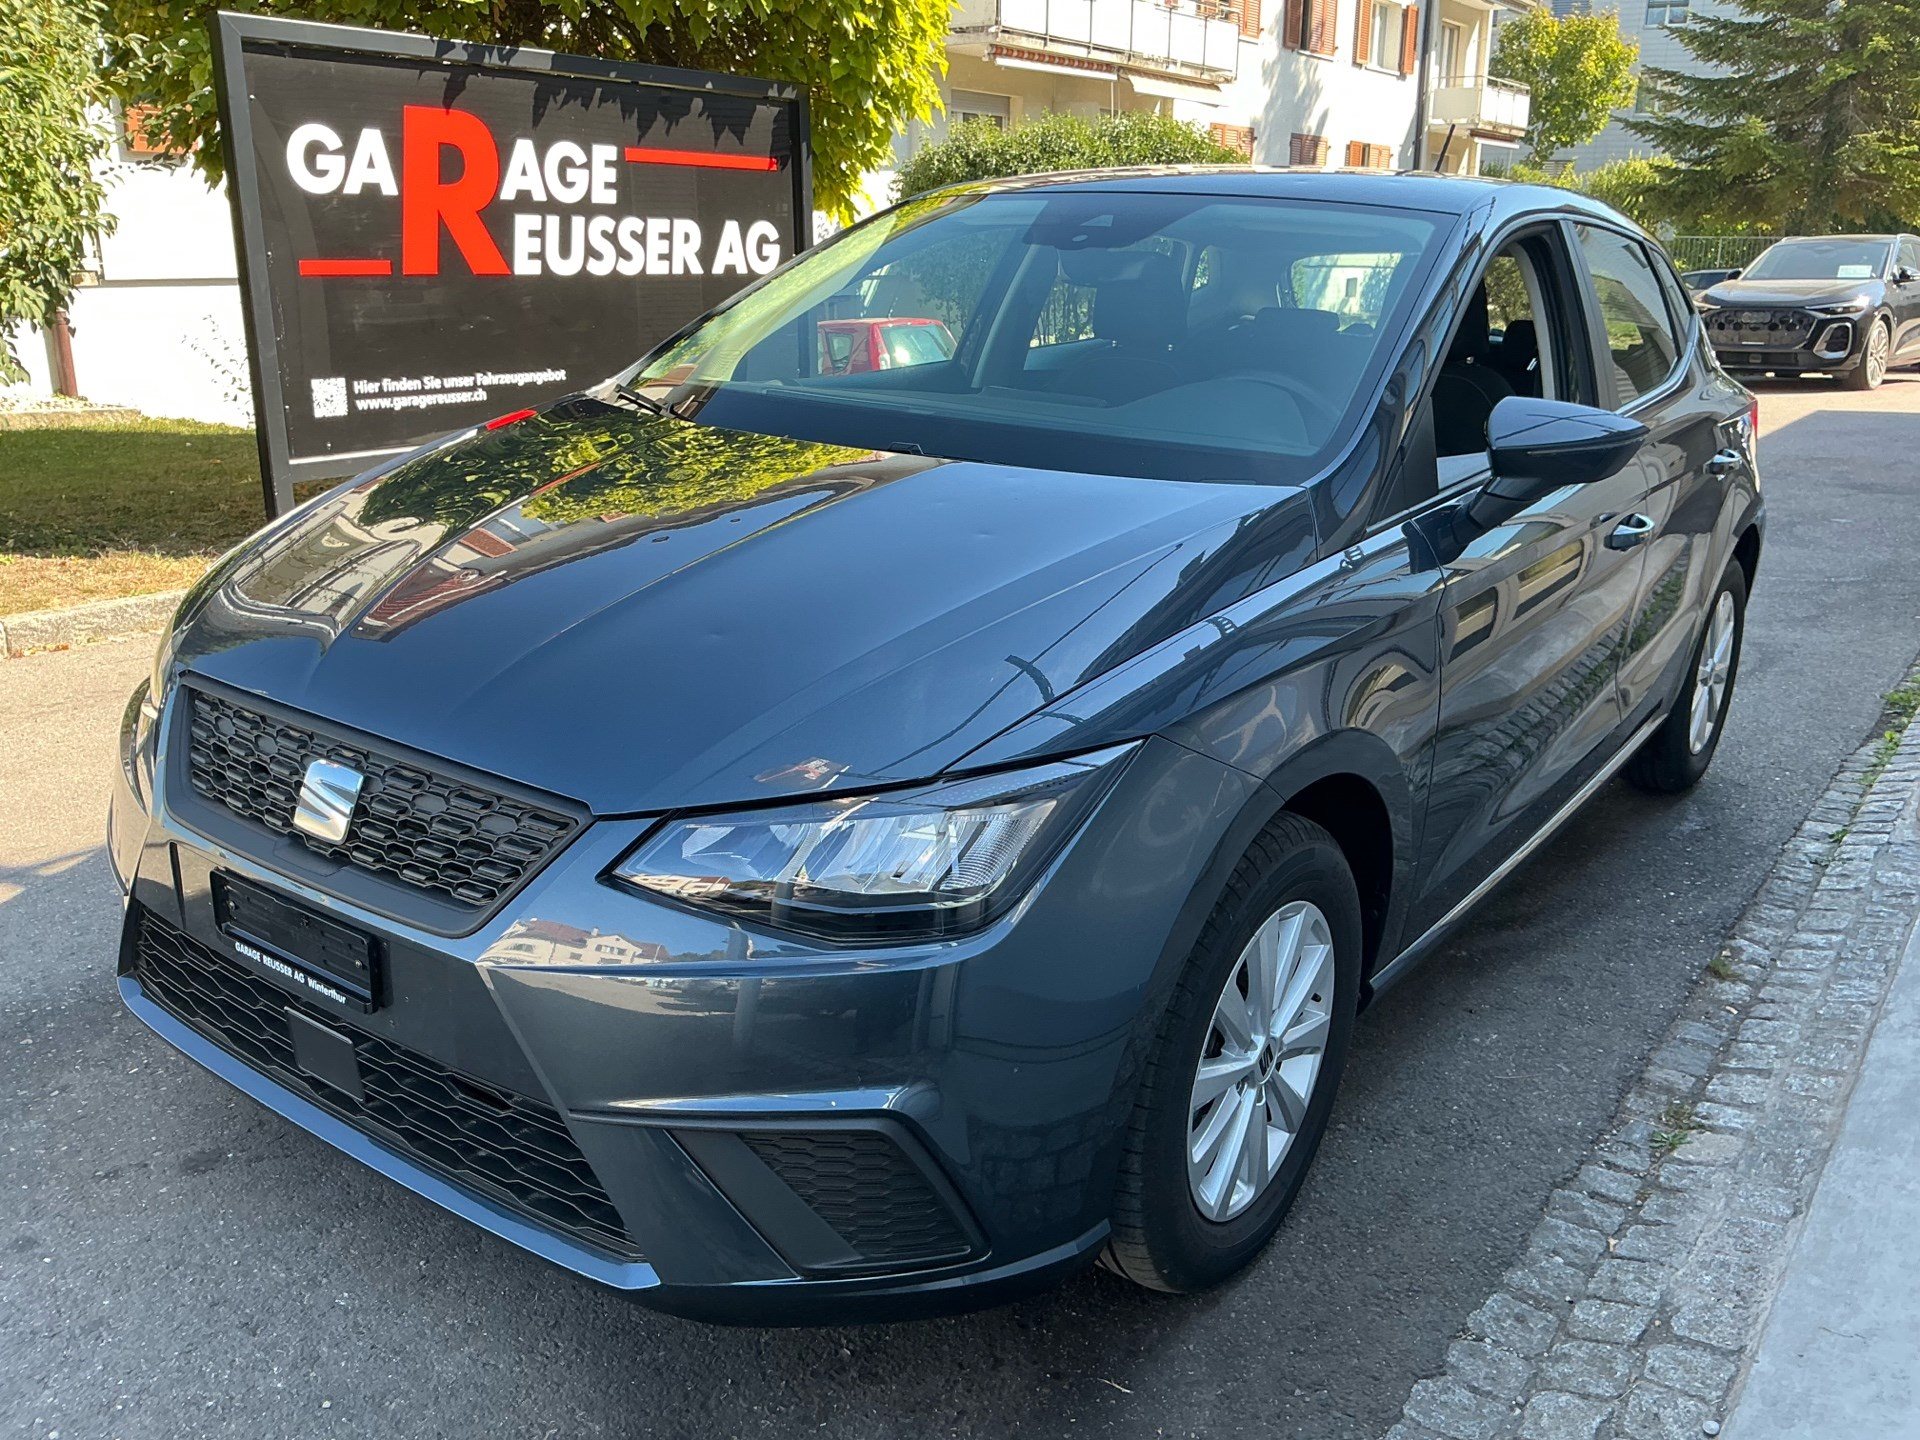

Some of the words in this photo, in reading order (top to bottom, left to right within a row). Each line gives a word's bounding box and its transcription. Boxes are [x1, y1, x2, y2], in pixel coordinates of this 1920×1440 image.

[286, 105, 617, 275] GARAGE
[711, 221, 781, 275] AG
[353, 380, 380, 394] Hier
[381, 377, 421, 391] finden
[423, 375, 441, 389] Sie
[443, 376, 475, 388] unser
[475, 368, 567, 387] Fahrzeugangebot
[355, 388, 487, 410] www.garagereusser.ch
[235, 941, 261, 962] GARAGE
[262, 955, 292, 977] REUSSER
[293, 970, 305, 983] AG
[307, 977, 347, 1004] Winterthur
